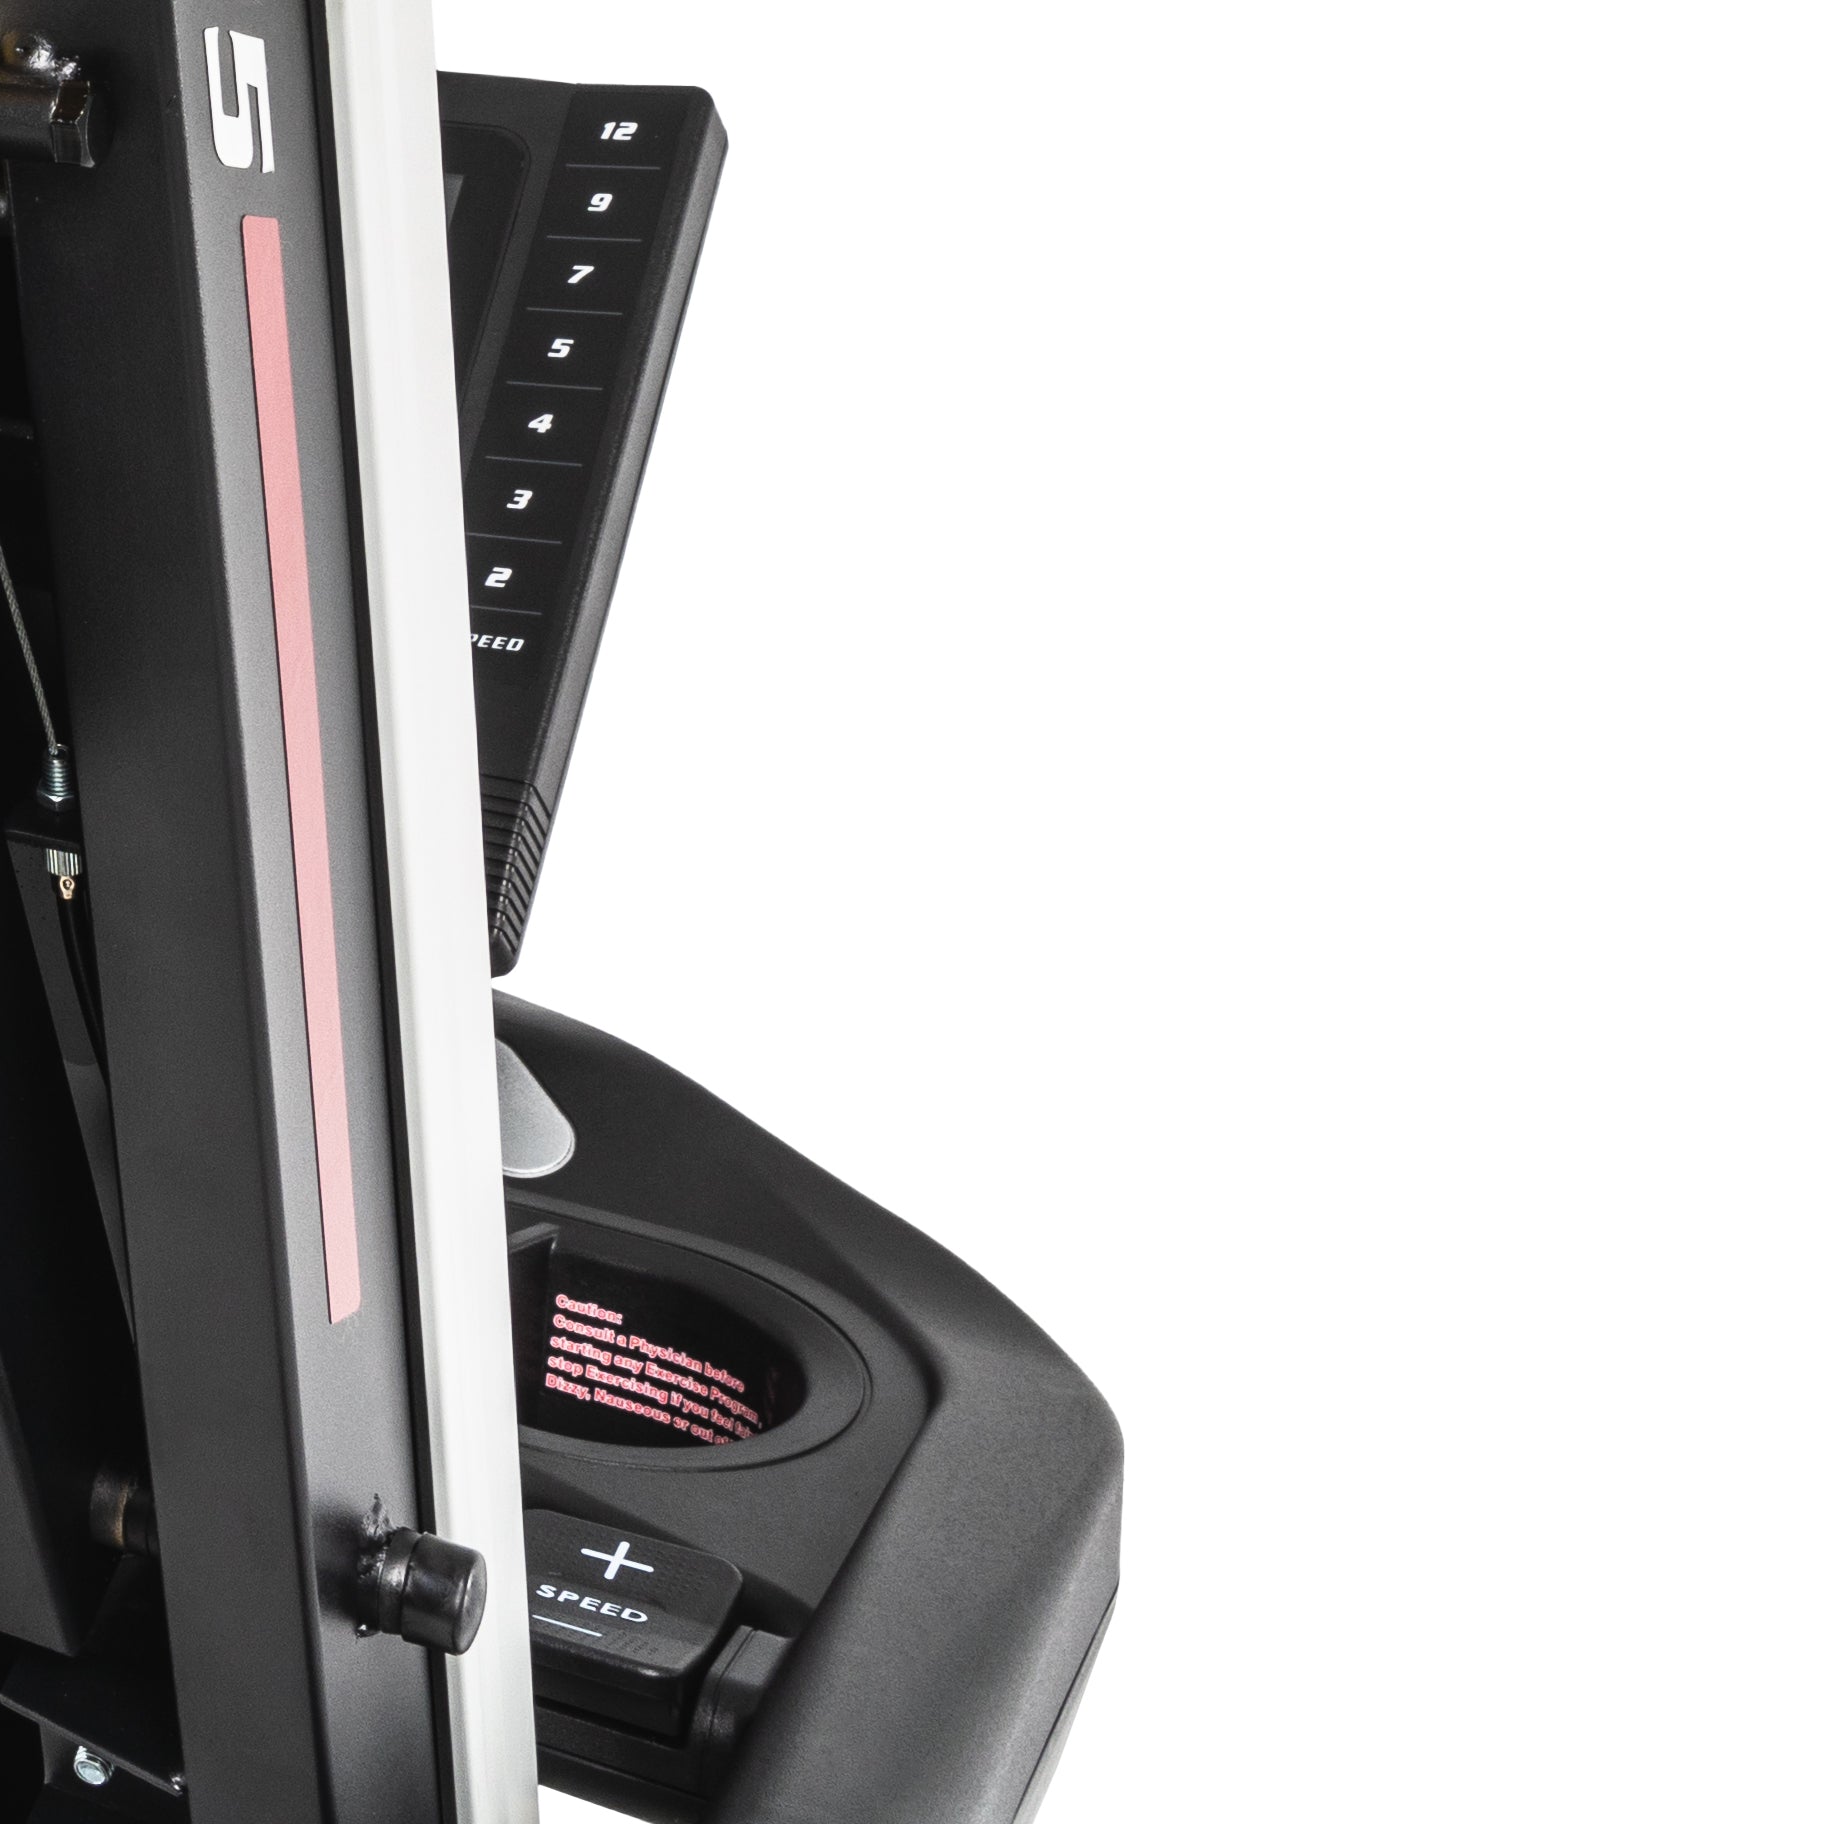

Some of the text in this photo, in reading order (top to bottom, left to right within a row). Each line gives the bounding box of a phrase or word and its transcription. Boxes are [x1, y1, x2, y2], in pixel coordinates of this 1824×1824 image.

[599, 121, 638, 141] 12
[587, 192, 613, 212] 9
[567, 265, 594, 284] 7
[547, 338, 574, 358] 5
[528, 413, 553, 433] 4
[506, 489, 533, 510] 3
[484, 566, 512, 588] 2
[470, 633, 525, 651] PEED
[555, 1293, 623, 1325] Caution:
[553, 1313, 745, 1393] Consult a Physician before
[549, 1336, 612, 1366] starting
[613, 1354, 644, 1374] any
[645, 1360, 708, 1397] Exercise
[547, 1355, 584, 1377] stop
[585, 1363, 668, 1405] Exercising
[670, 1390, 683, 1407] if
[682, 1398, 709, 1419] you
[710, 1408, 734, 1432] feel
[545, 1372, 591, 1401] Dizzy,
[593, 1387, 671, 1425] Nauseous
[673, 1416, 690, 1431] or
[690, 1424, 714, 1443] out
[535, 1583, 648, 1623] SPEED
